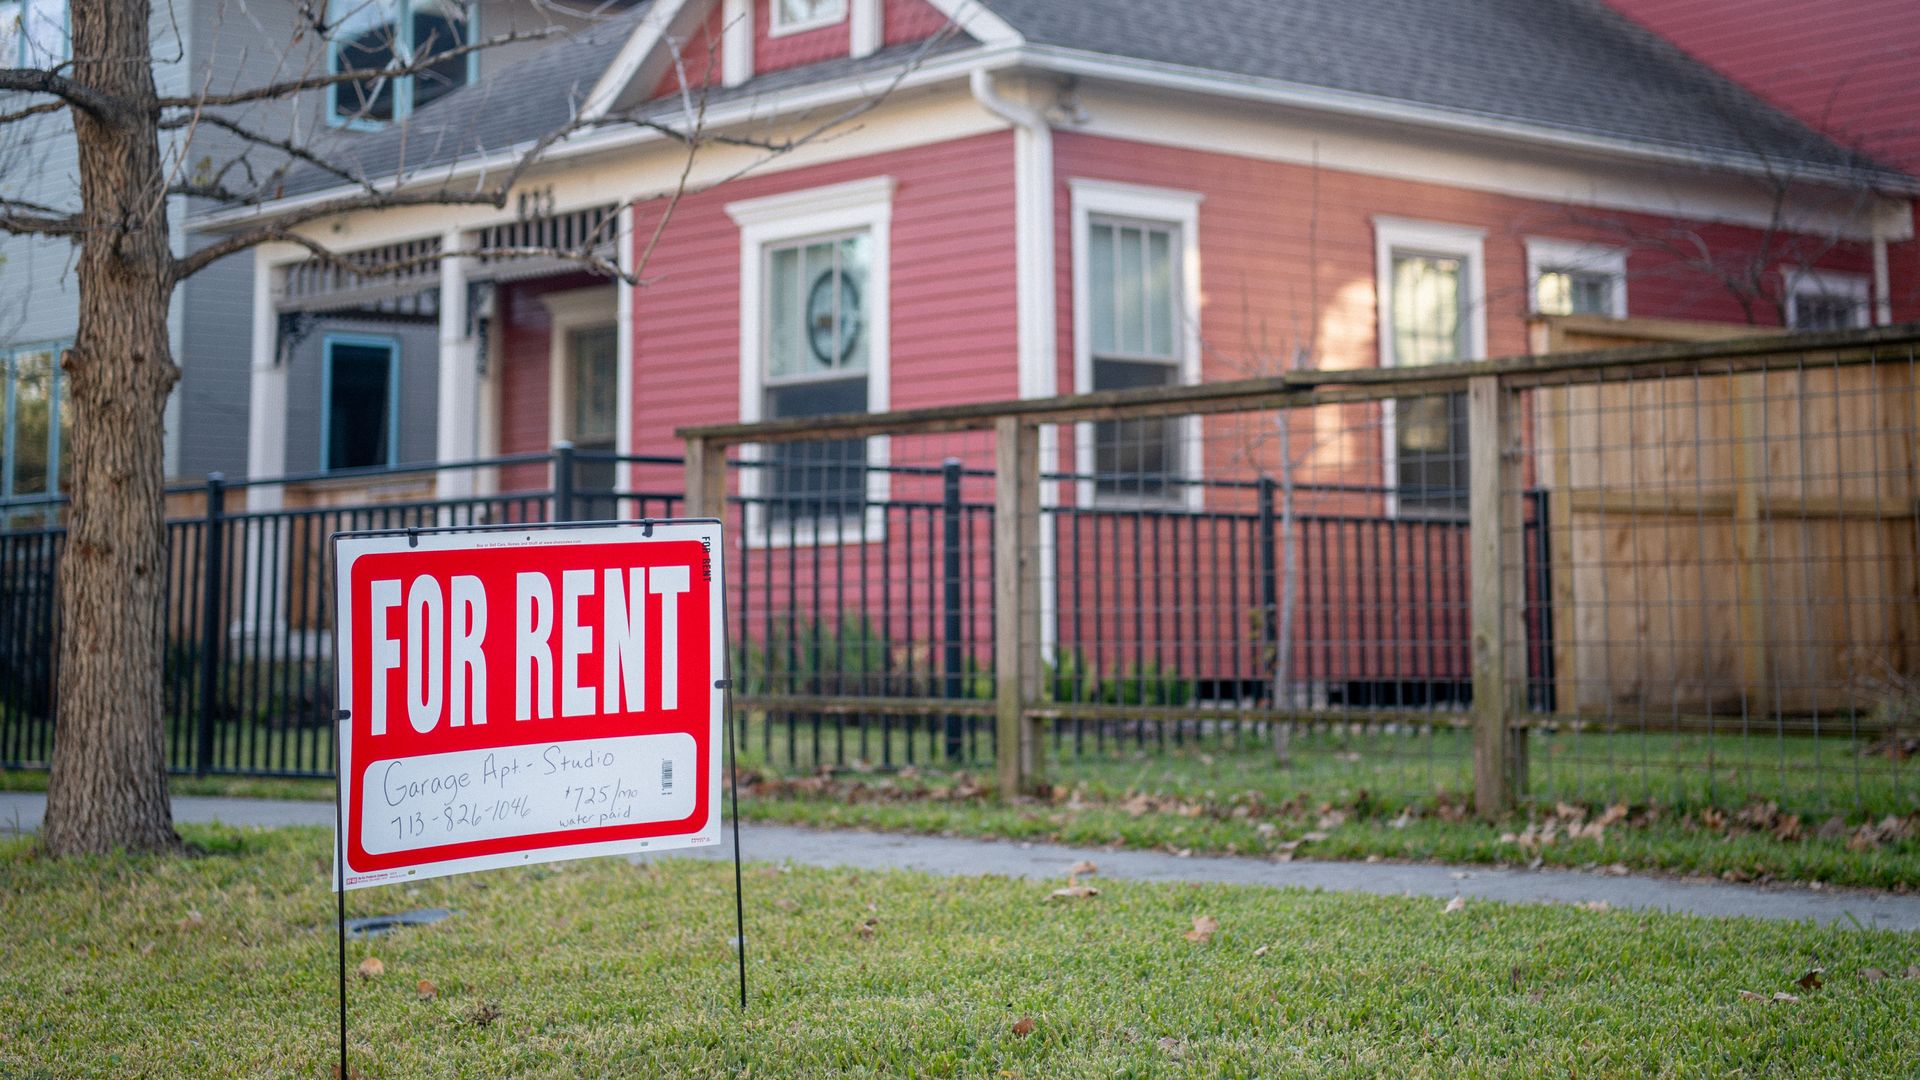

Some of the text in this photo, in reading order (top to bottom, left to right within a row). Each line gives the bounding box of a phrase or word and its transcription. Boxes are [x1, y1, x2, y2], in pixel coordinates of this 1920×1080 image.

[701, 536, 712, 582] FOR RENT
[371, 565, 690, 736] FOR RENT
[383, 760, 471, 806] Garage
[543, 745, 614, 776] Studio
[391, 794, 532, 839] 713-826-1046
[560, 804, 631, 828] water paid
